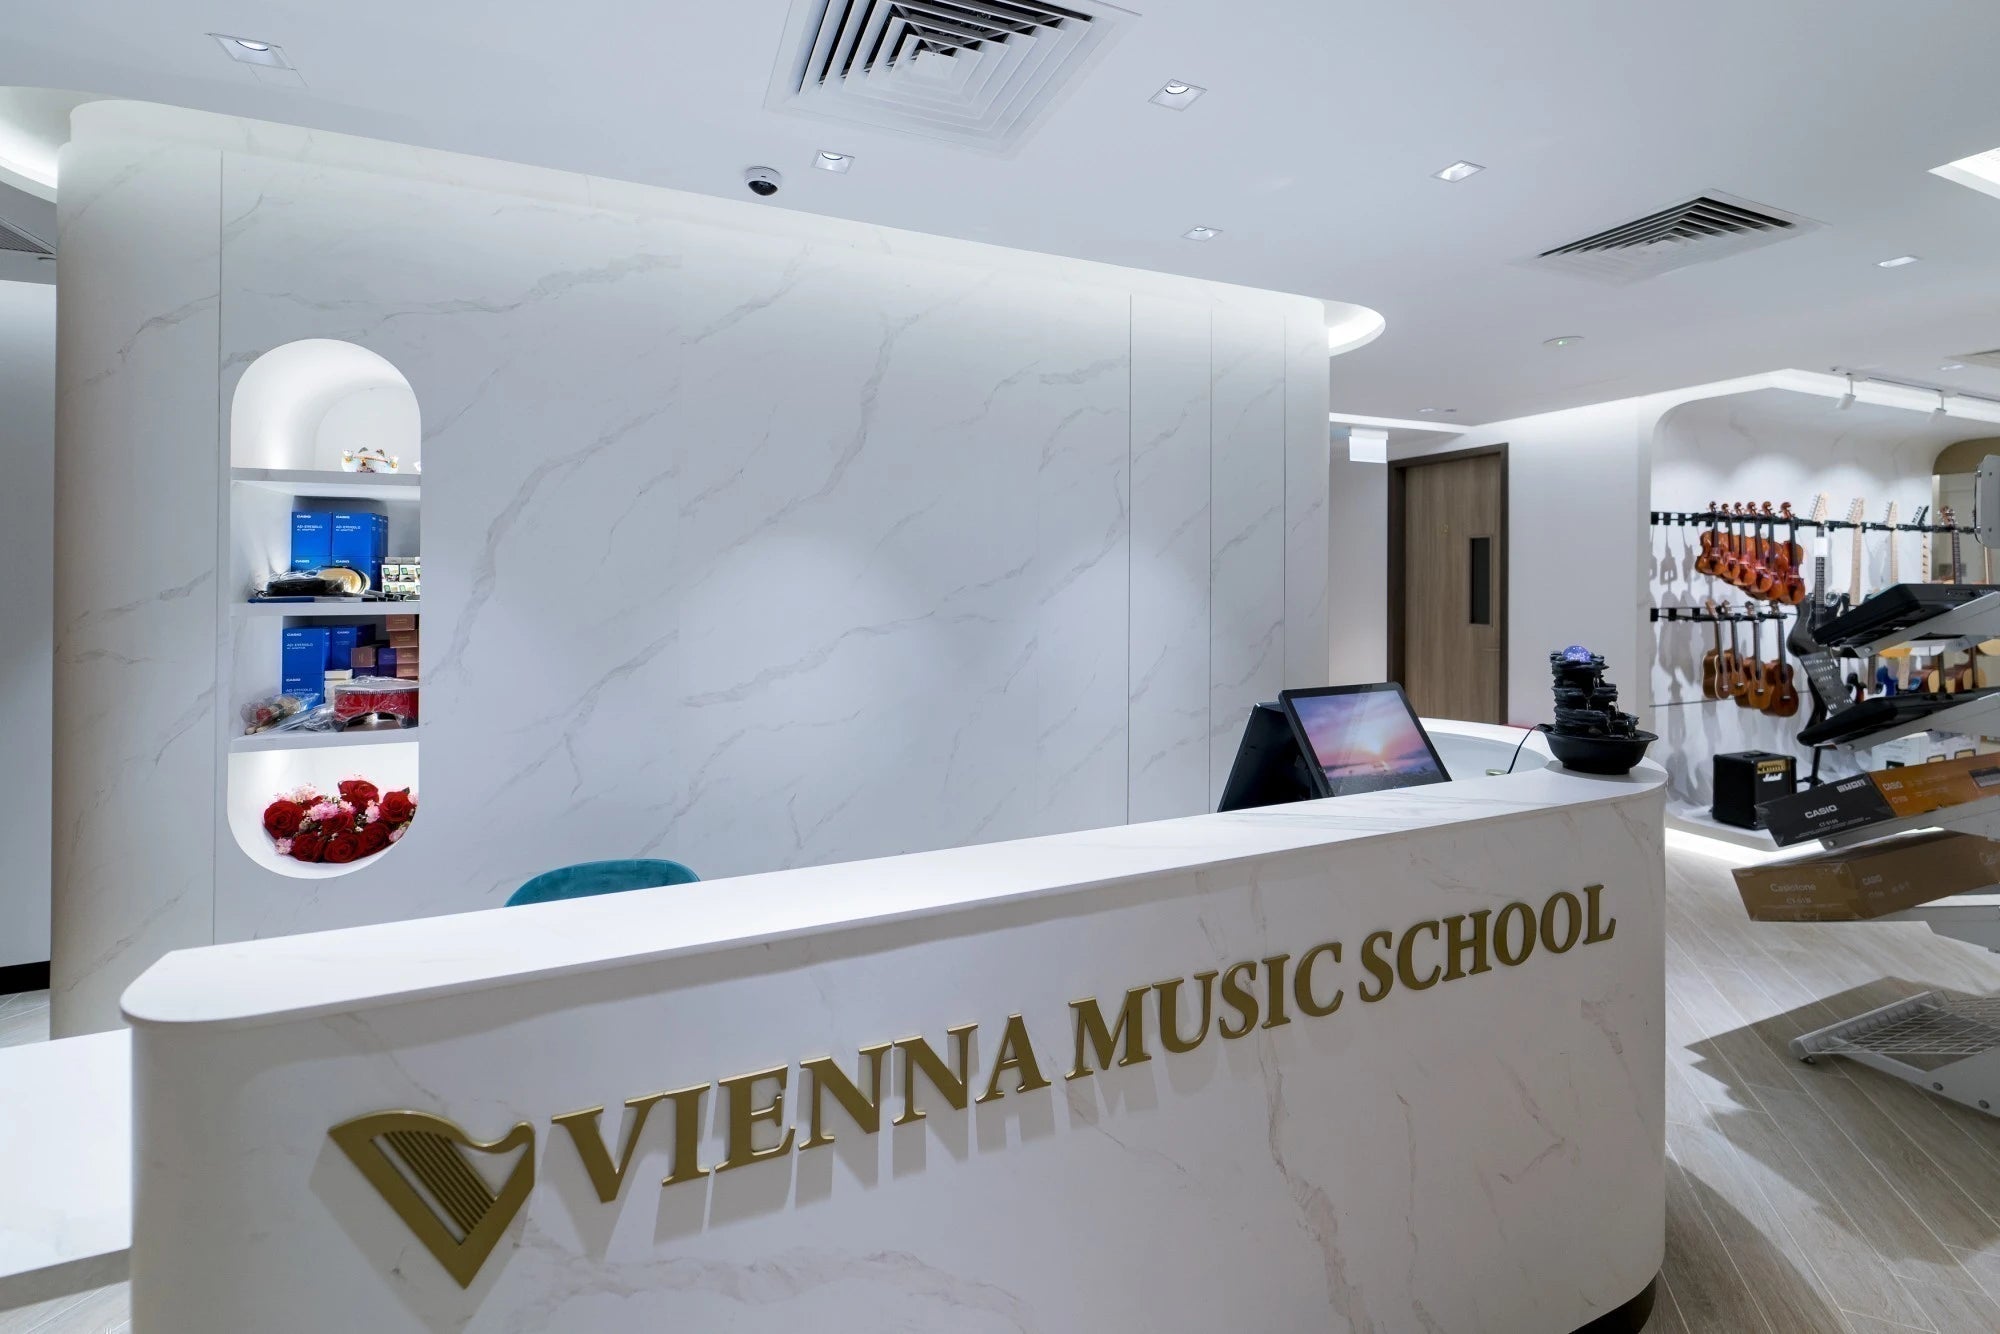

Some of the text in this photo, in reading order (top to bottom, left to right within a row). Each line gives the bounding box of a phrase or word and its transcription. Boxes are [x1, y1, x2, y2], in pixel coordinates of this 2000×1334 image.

[1882, 780, 1904, 791] CASIO
[1804, 804, 1838, 819] CASIO
[551, 883, 1617, 1204] VIENNA MUSIC SCHOOL
